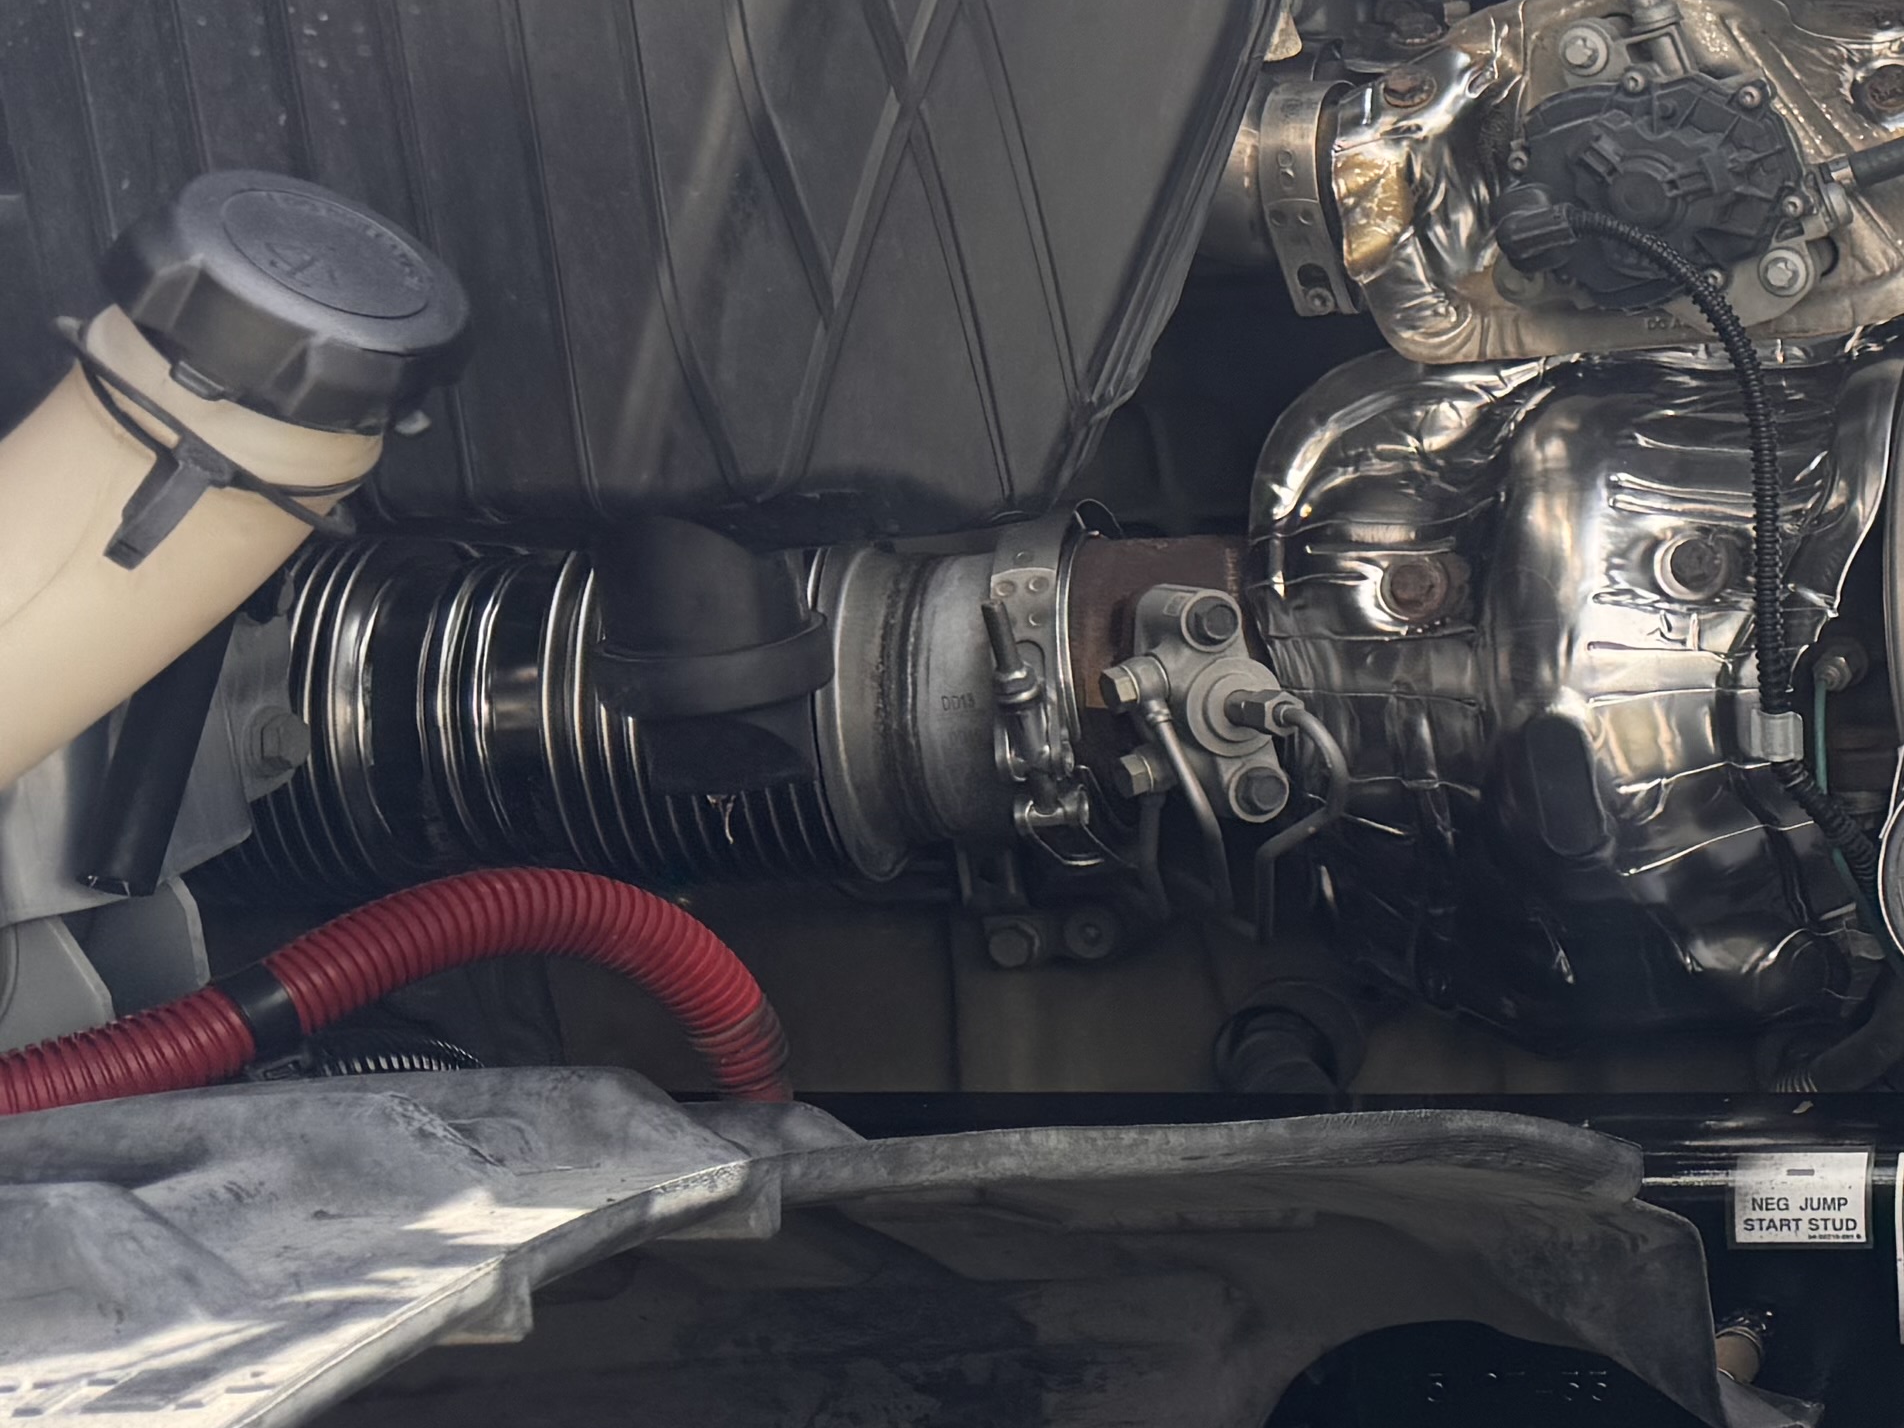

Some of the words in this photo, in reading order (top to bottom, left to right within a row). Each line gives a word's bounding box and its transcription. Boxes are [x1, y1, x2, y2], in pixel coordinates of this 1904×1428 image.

[1751, 1196, 1790, 1212] NEG
[1799, 1196, 1848, 1212] JUMP
[1743, 1218, 1803, 1232] START
[1808, 1217, 1858, 1232] STUD
